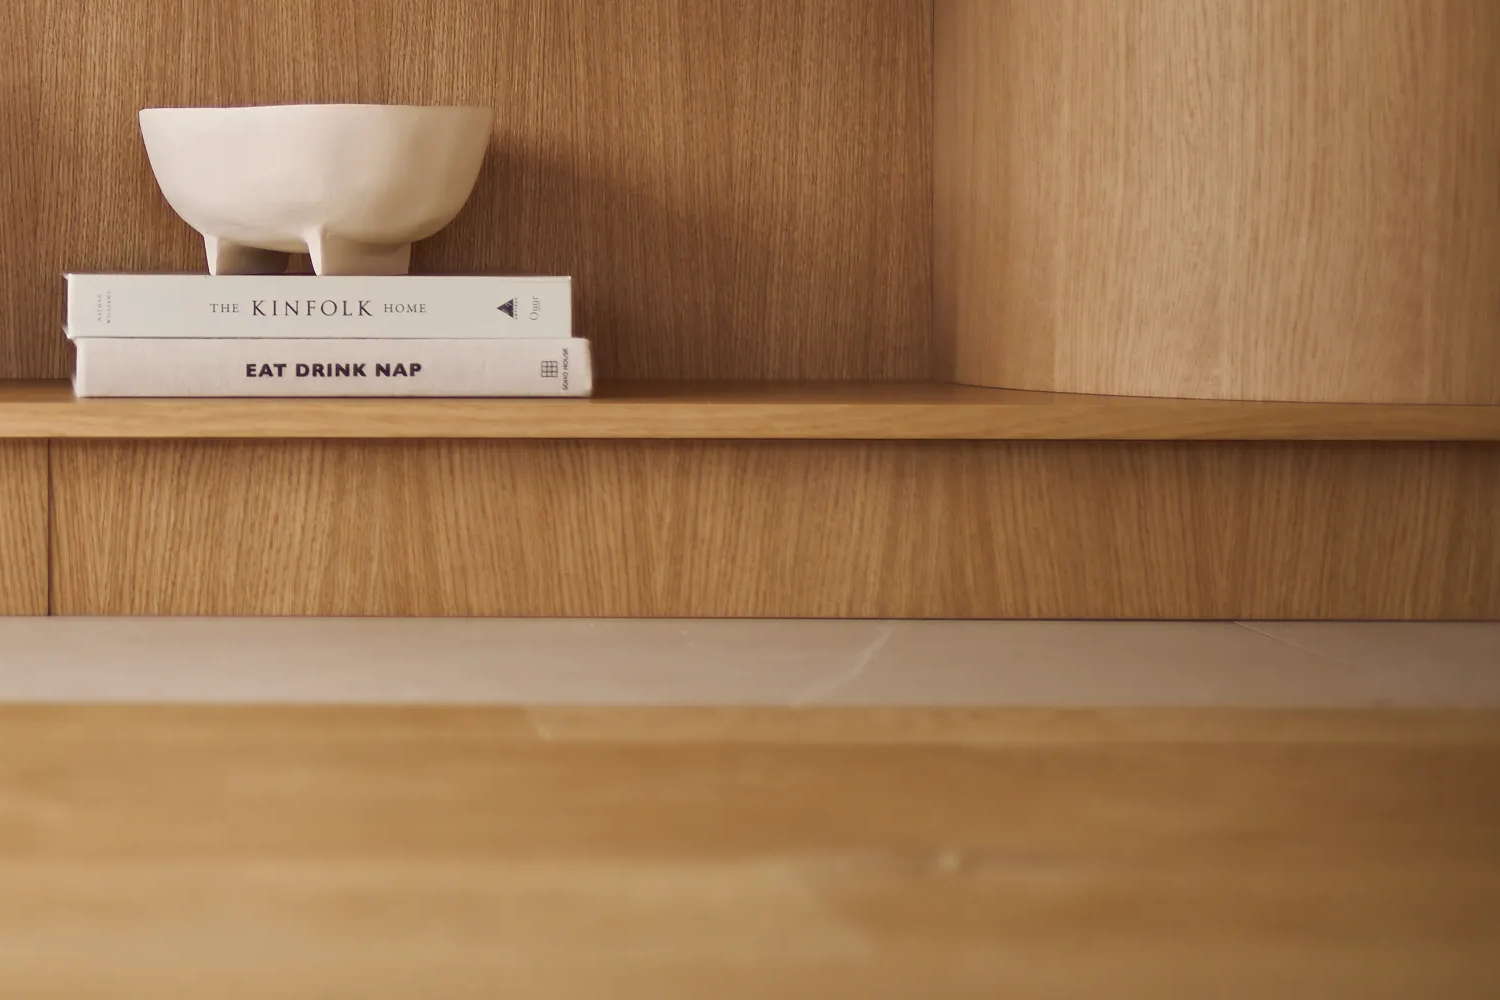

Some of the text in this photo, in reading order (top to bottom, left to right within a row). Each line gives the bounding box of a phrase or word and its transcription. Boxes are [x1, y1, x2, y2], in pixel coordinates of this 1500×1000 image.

[209, 300, 427, 316] THE KINFOLK HOME
[246, 363, 422, 377] EAT DRINK NAP
